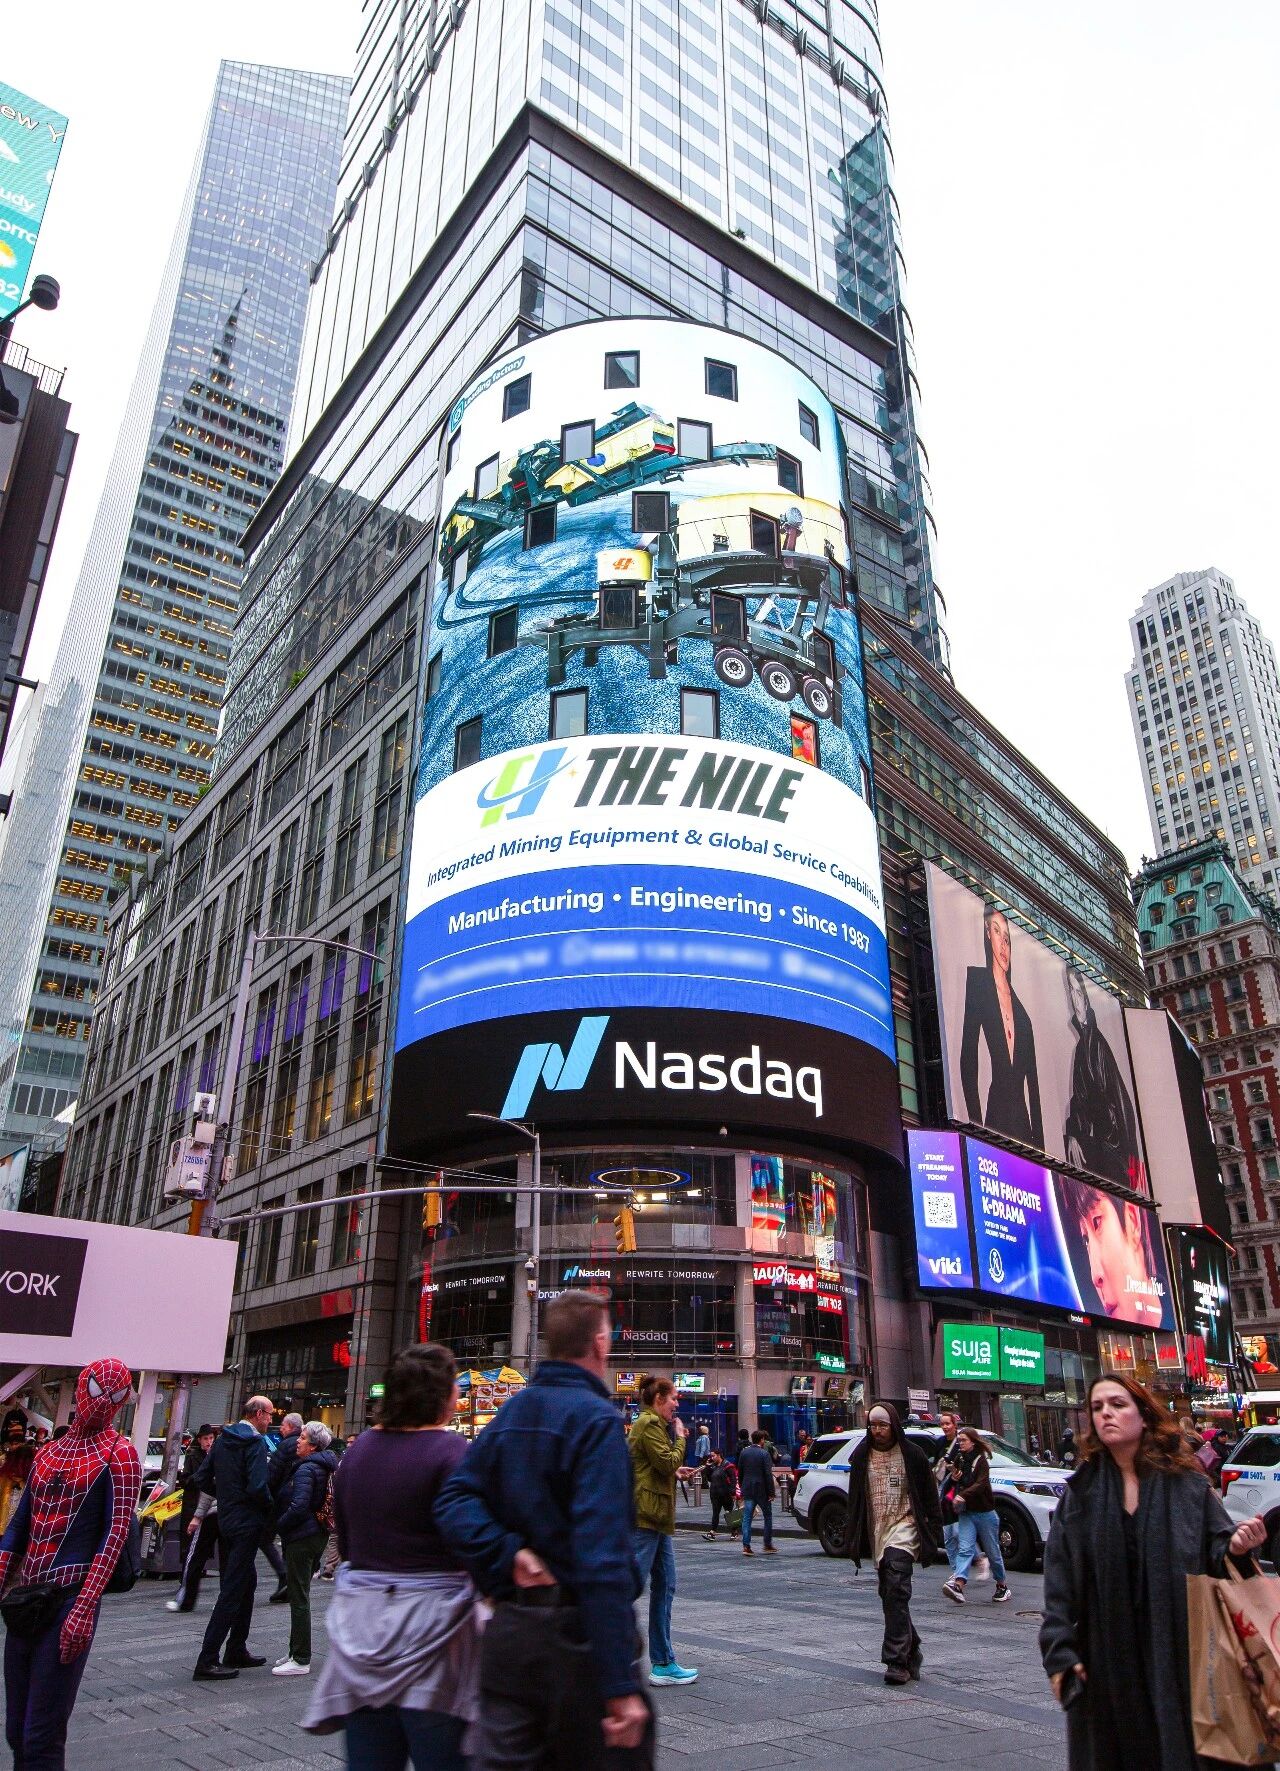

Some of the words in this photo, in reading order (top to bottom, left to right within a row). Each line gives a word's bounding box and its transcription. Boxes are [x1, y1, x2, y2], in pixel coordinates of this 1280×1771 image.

[0, 104, 40, 131] ew
[574, 745, 689, 808] THE
[679, 751, 805, 824] NILE
[427, 844, 496, 888] Integrated
[499, 834, 562, 858] Mining
[568, 827, 680, 849] Equipment
[684, 829, 703, 846] &
[708, 832, 768, 855] Global
[773, 843, 827, 873] Service
[830, 863, 880, 910] Capabilities
[447, 888, 604, 935] Manufacturing
[630, 886, 773, 923] Engineering
[791, 905, 838, 937] Since
[841, 922, 870, 954] 1987
[615, 1041, 824, 1118] Nasdaq
[917, 1163, 955, 1172] STREAMING
[925, 1153, 944, 1161] START
[978, 1156, 999, 1177] 2026
[926, 1173, 948, 1181] TODAY
[980, 1176, 1000, 1197] FAN
[1000, 1181, 1042, 1212] FAVORITE
[982, 1195, 1027, 1226] K-DRAMA
[578, 1269, 611, 1279] Nasdaq
[626, 1270, 664, 1278] REWRITE
[667, 1270, 716, 1279] TOMORROW
[928, 1256, 962, 1275] Viki
[445, 1279, 467, 1288] REWRITE
[469, 1275, 505, 1286] TOMORROW
[623, 1330, 668, 1344] Nasdaq
[780, 1336, 802, 1348] Nasdaq
[951, 1339, 992, 1364] suja
